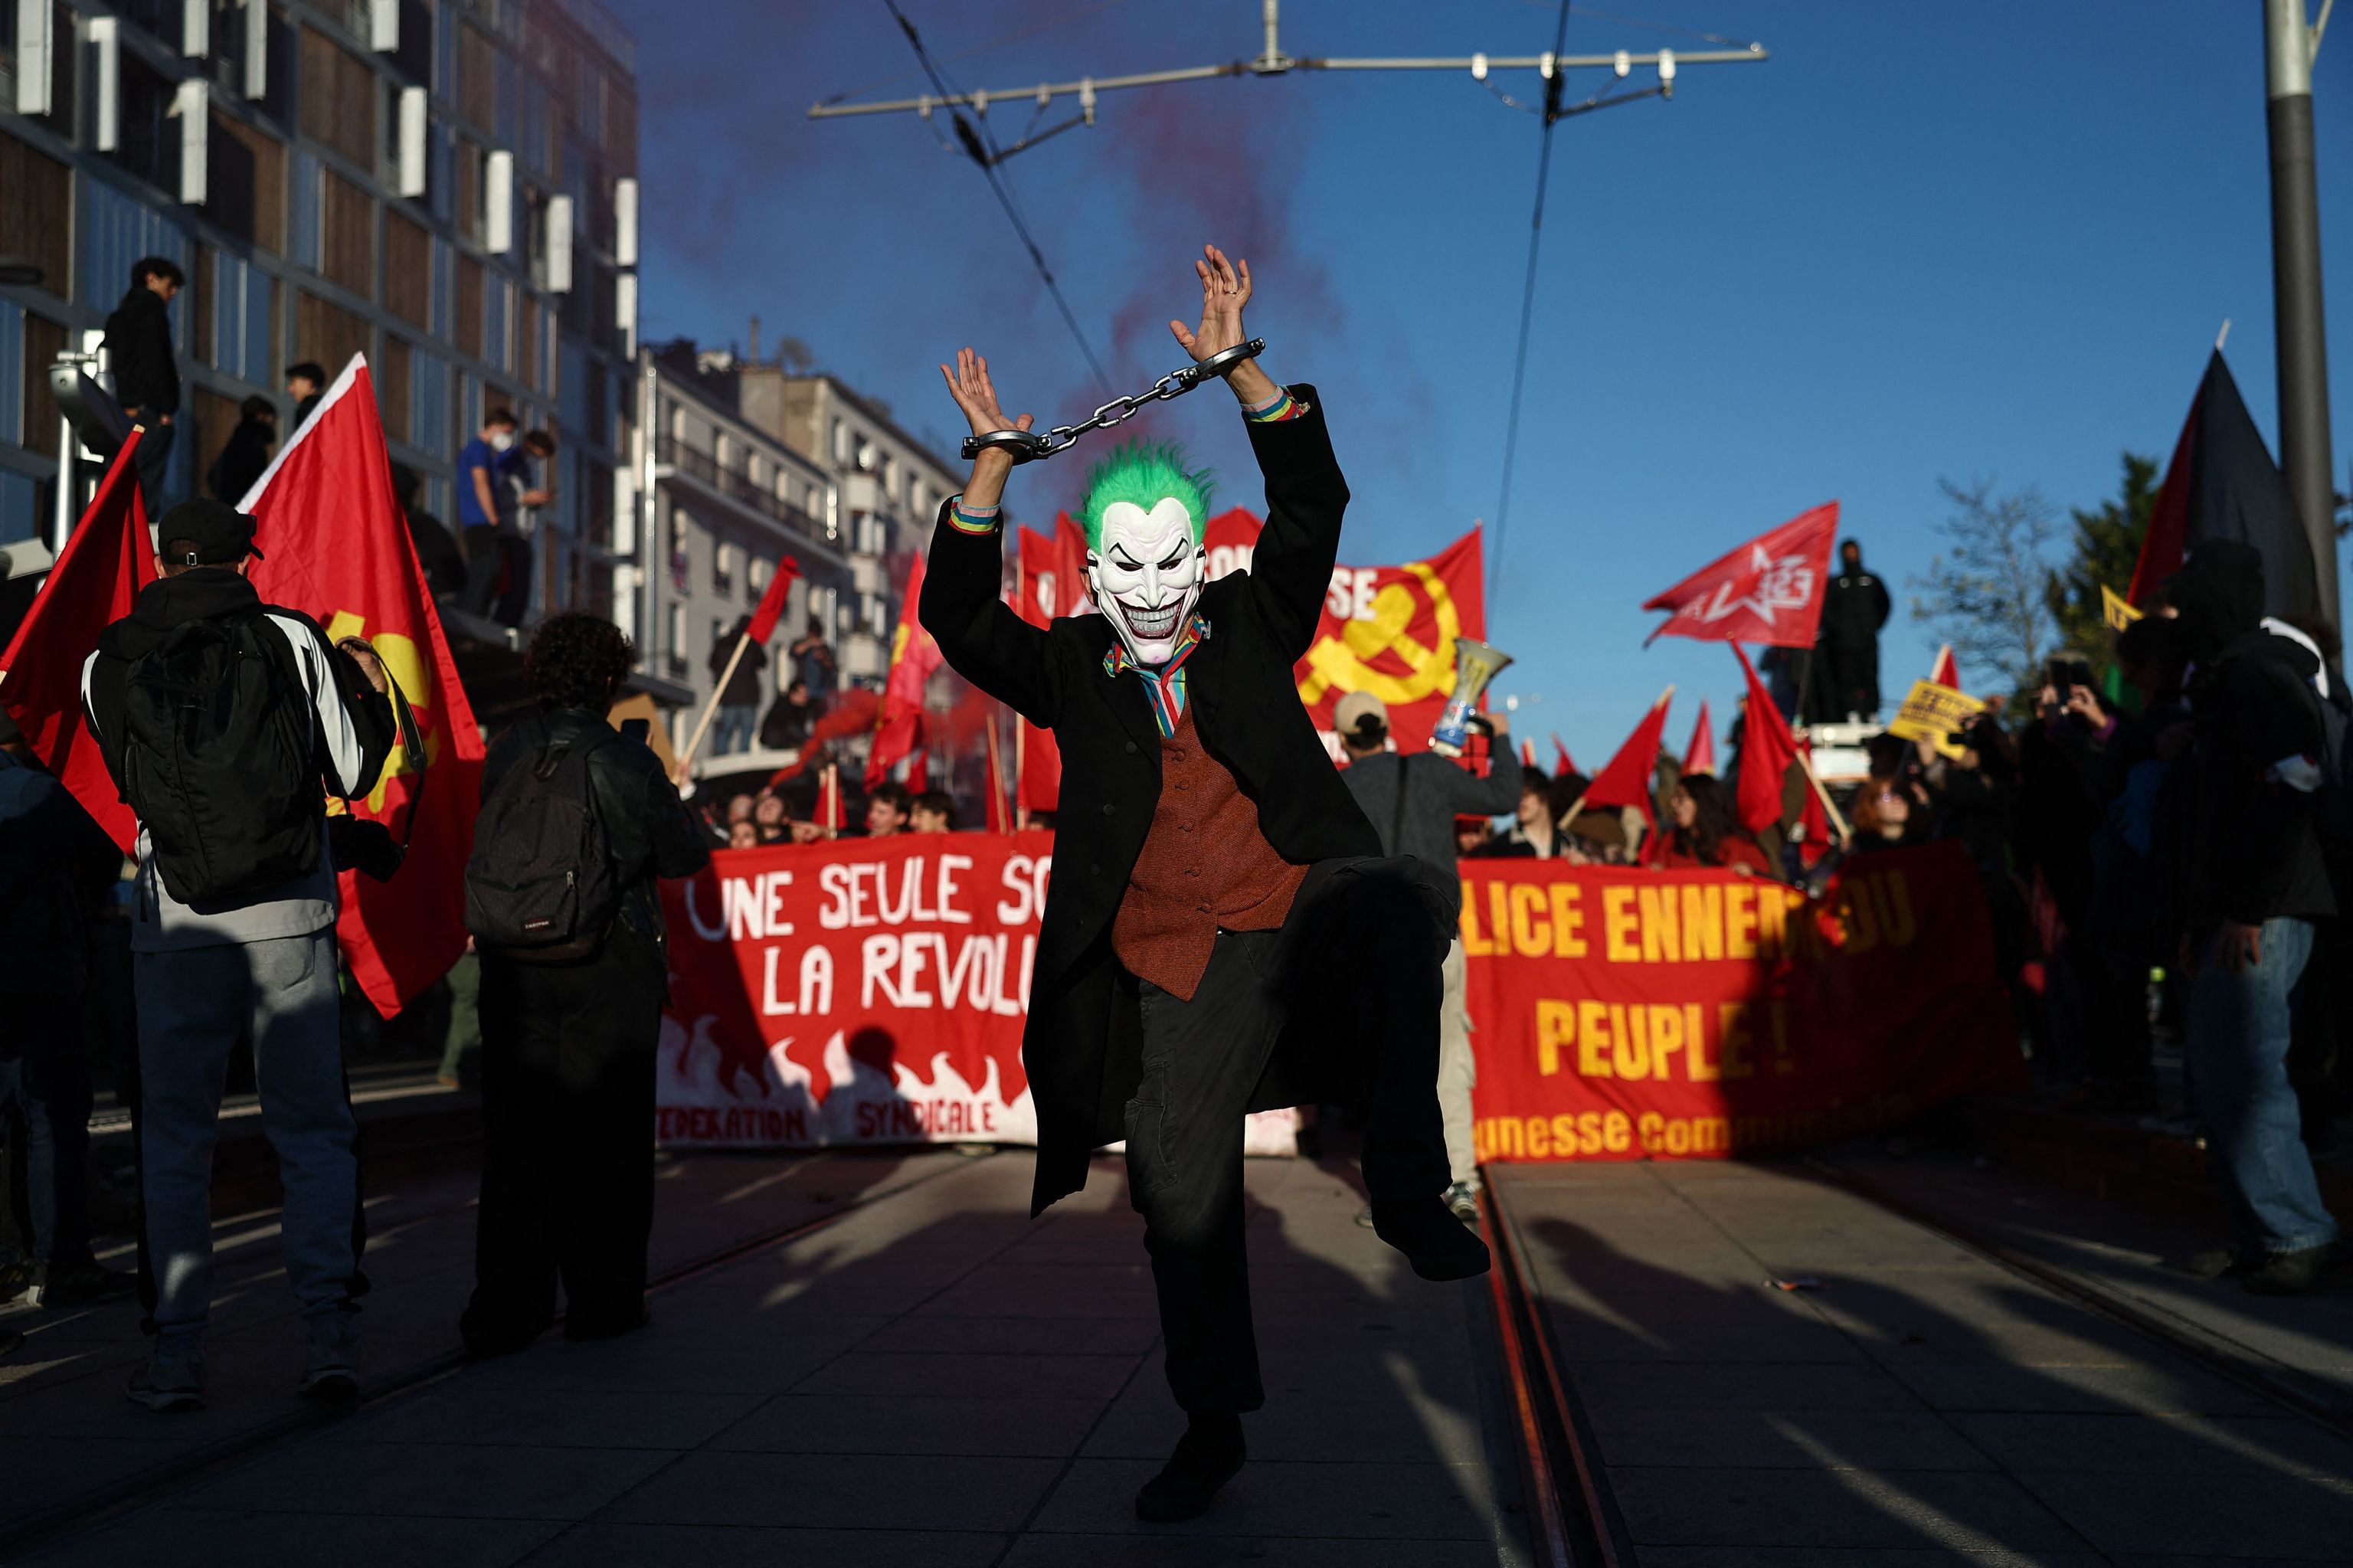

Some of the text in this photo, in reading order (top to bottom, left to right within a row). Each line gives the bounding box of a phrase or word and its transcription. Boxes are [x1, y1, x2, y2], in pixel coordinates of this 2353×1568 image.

[1326, 567, 1378, 622] SE
[684, 870, 795, 942] UNE
[819, 853, 973, 930] SEULE
[1458, 879, 1588, 957] LICE
[762, 944, 834, 1016] LA
[1535, 997, 1756, 1082] PEUPLE
[653, 1100, 997, 1141] EDERATION SYNDICALE
[1474, 1108, 1632, 1160] unesse
